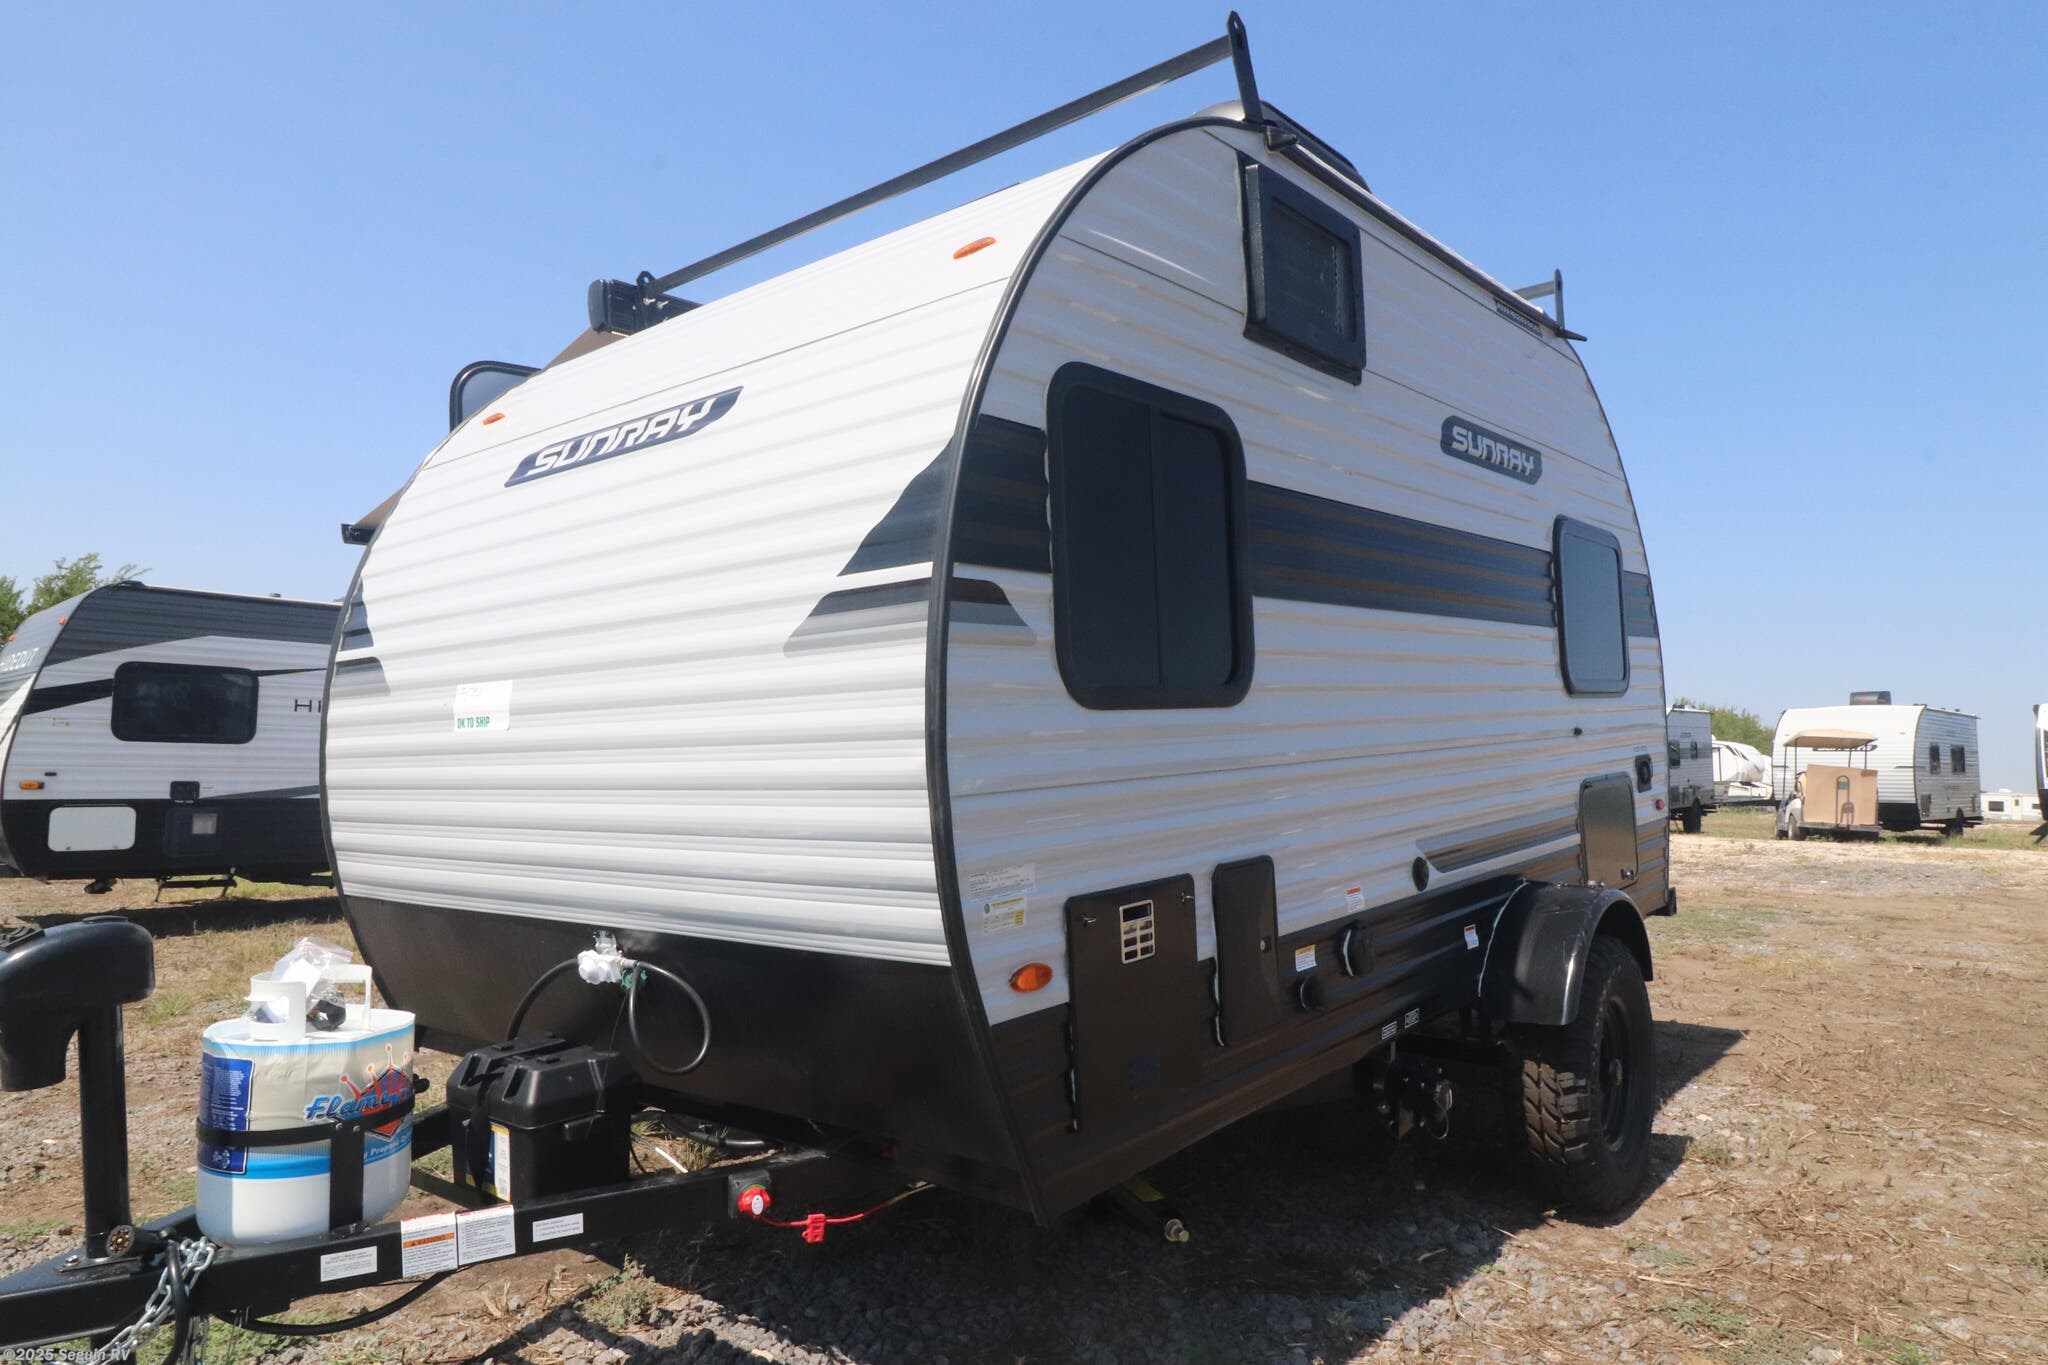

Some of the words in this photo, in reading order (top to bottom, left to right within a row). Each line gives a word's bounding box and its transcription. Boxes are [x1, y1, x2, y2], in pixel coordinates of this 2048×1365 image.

[526, 398, 718, 476] SUNRAY
[1451, 425, 1534, 476] SUNRAY
[457, 717, 465, 729] OK
[466, 717, 474, 729] TO
[475, 715, 490, 728] SHIP
